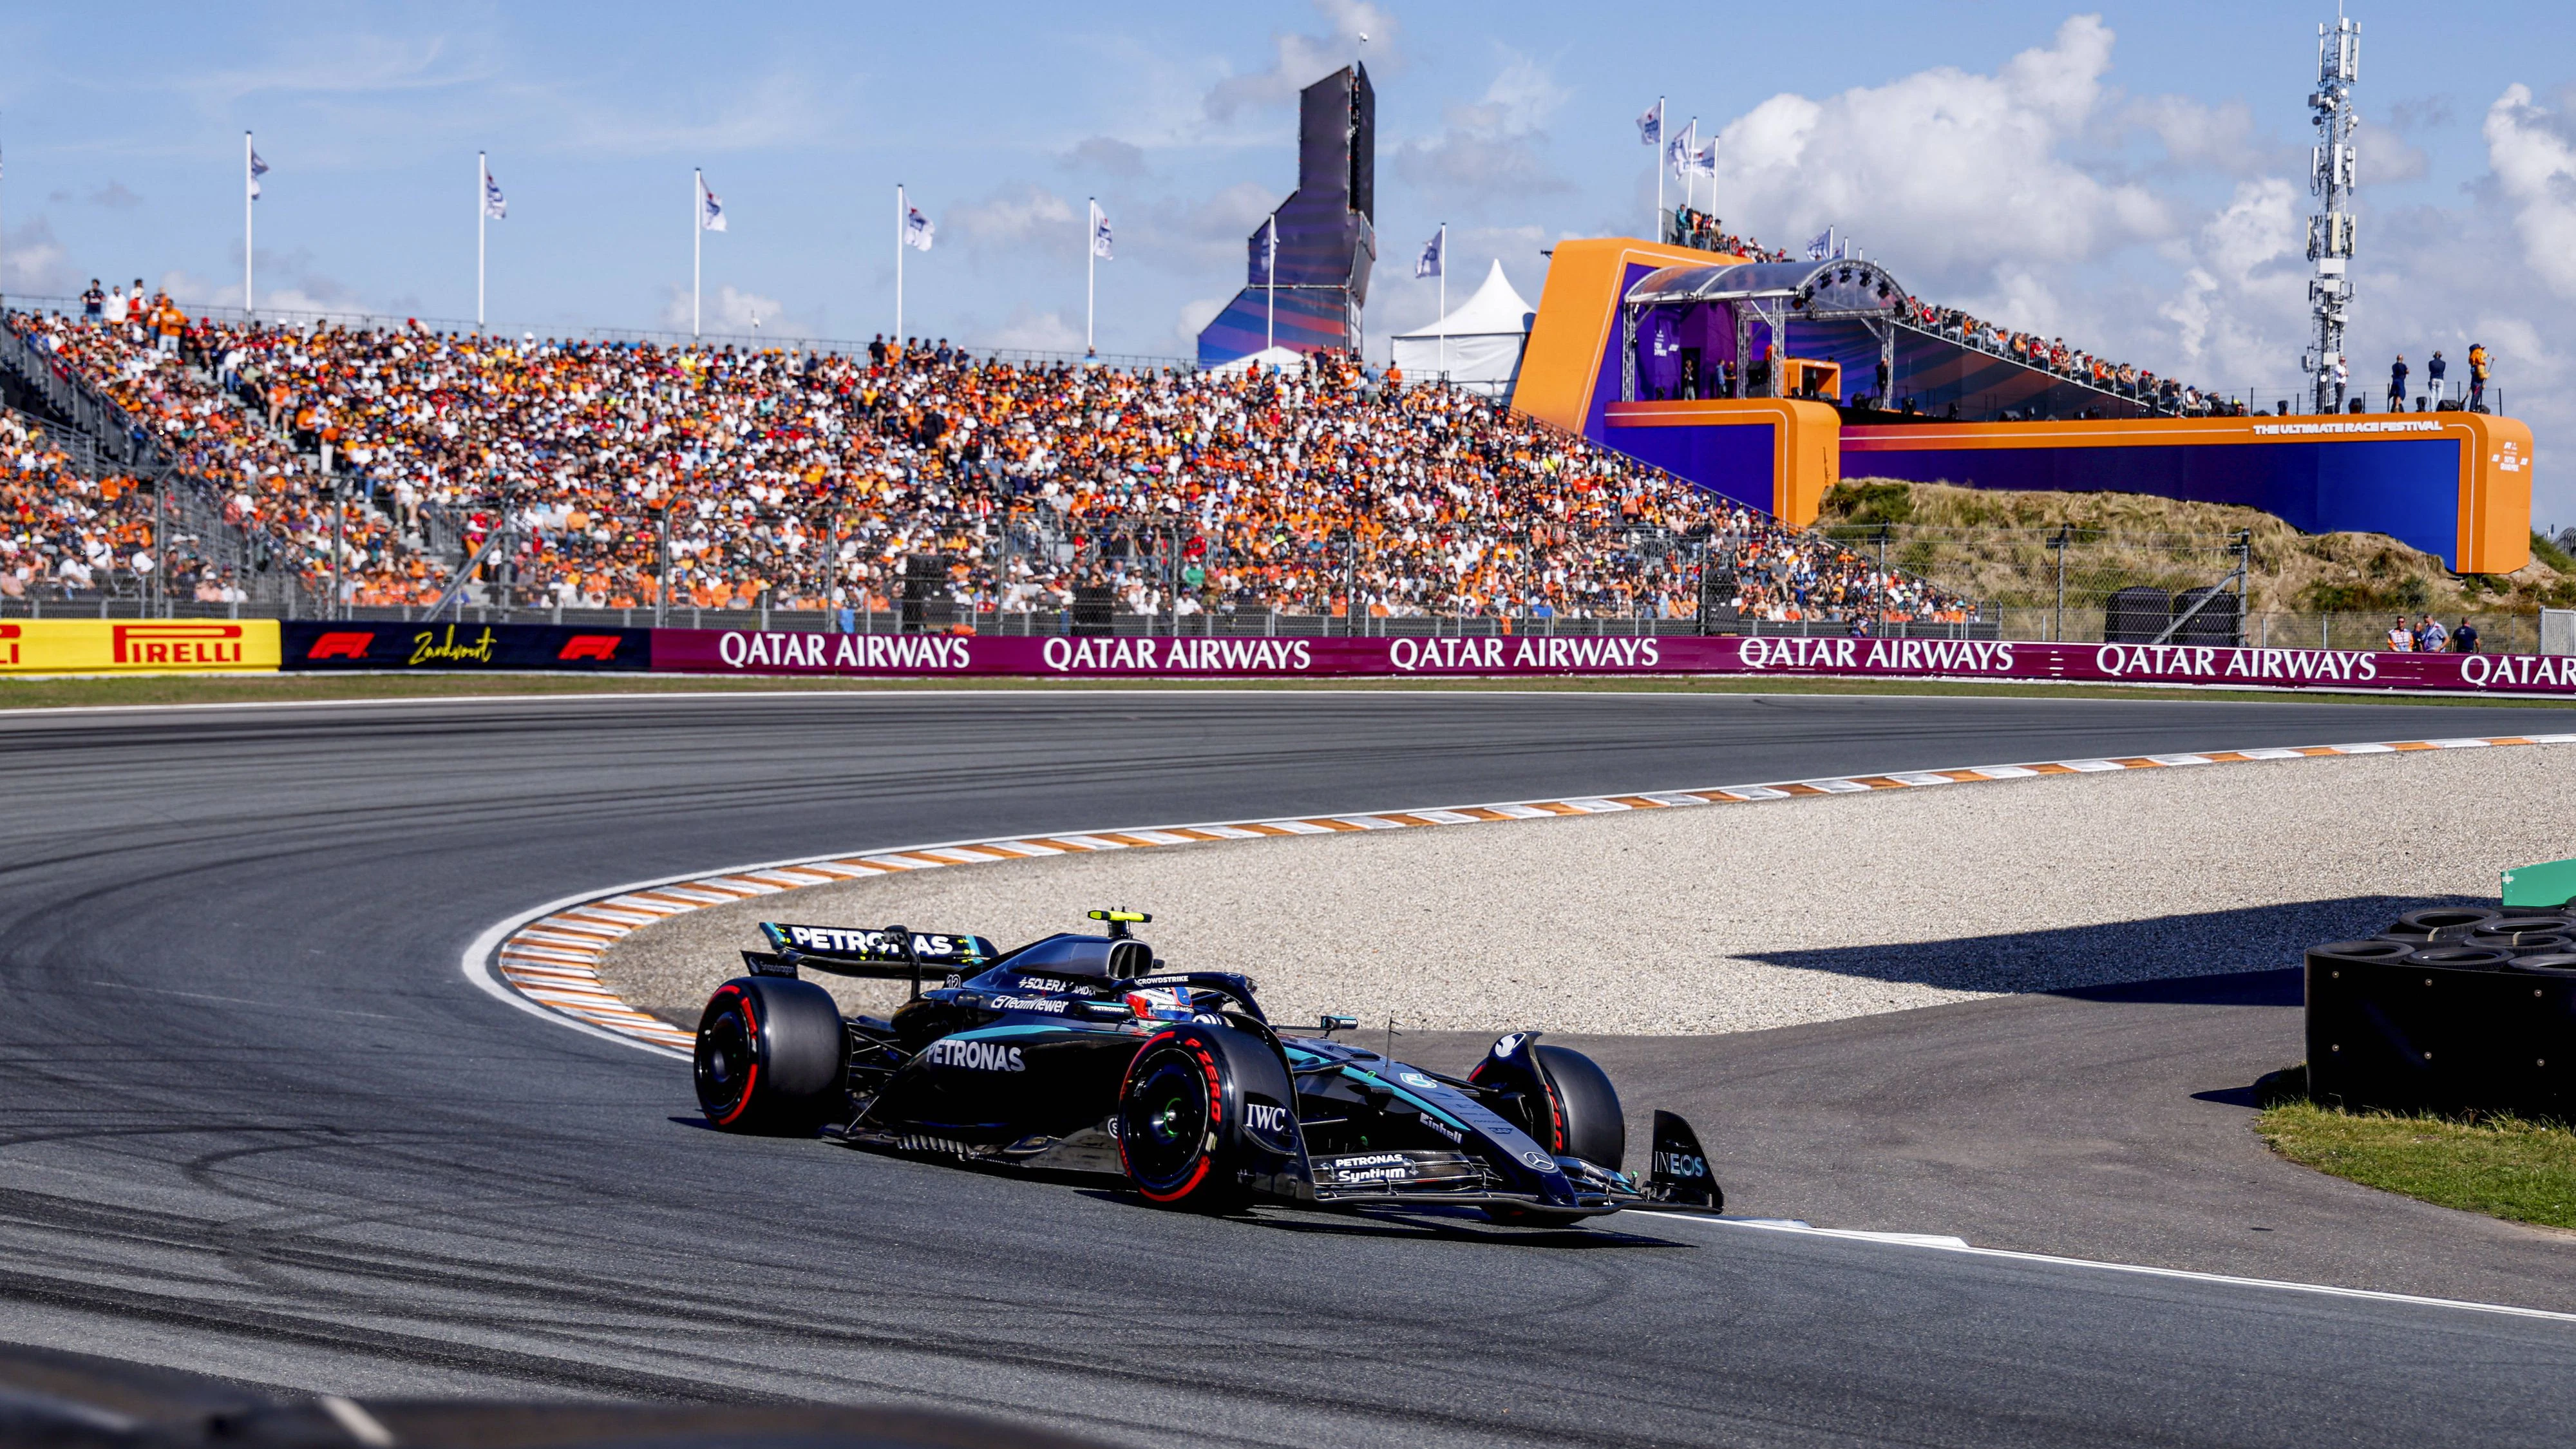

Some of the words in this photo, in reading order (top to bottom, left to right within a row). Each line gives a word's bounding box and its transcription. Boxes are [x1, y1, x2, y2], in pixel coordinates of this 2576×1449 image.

[2253, 424, 2280, 435] THE
[2280, 422, 2345, 435] ULTIMATE
[2345, 422, 2379, 433] RACE
[2380, 421, 2443, 432] FESTIVAL
[113, 625, 242, 663] PIRELLI
[719, 632, 828, 668] QATAR
[835, 634, 971, 668] AIRWAYS
[1043, 637, 1159, 672] QATAR
[1165, 639, 1311, 670] AIRWAYS
[1390, 638, 1506, 671] QATAR
[1513, 638, 1660, 667] AIRWAYS
[1739, 636, 1857, 669] QATAR
[1865, 639, 2014, 671] AIRWAYS
[2096, 645, 2215, 677] QATAR
[2224, 649, 2377, 681] AIRWAYS
[2460, 655, 2576, 687] QATAR
[1025, 977, 1066, 992] SOLERA
[1071, 985, 1090, 996] AMD
[1138, 975, 1189, 985] CROWDSTRIKE
[1004, 996, 1069, 1013] TeamViewer
[926, 1039, 1025, 1072] PETRONAS
[1184, 1037, 1202, 1048] P
[1197, 1050, 1222, 1122] ZERO
[1245, 1103, 1286, 1132] IWC
[1419, 1112, 1463, 1144] Einhell
[1335, 1153, 1403, 1168] PETRONAS
[1338, 1168, 1406, 1183] Syntium
[1654, 1151, 1704, 1177] INEOS
